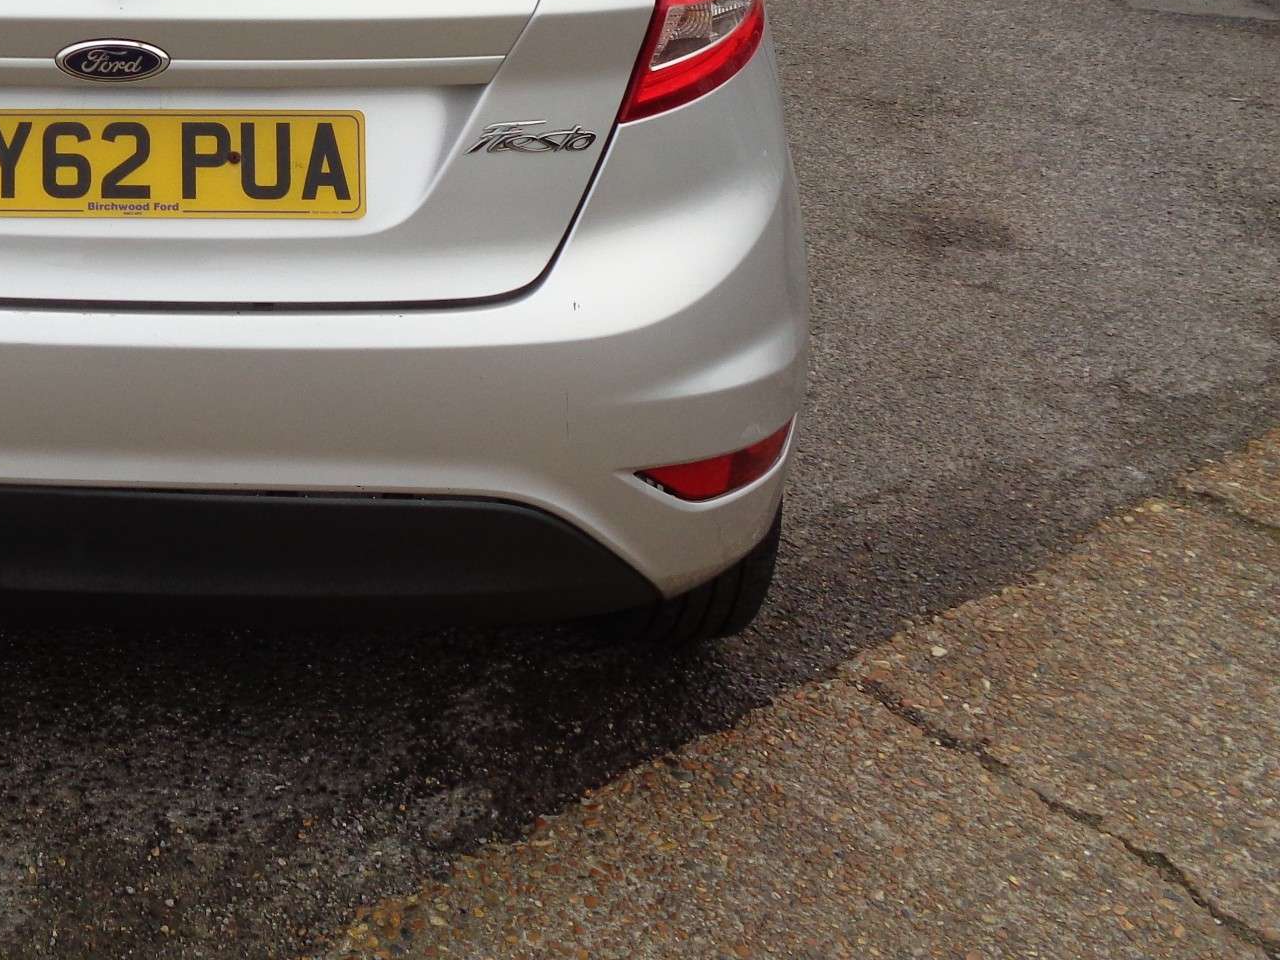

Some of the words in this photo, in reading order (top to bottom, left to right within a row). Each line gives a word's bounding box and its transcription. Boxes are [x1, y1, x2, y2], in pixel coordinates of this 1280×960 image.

[81, 48, 143, 74] Ford
[181, 121, 352, 201] PUA
[87, 202, 150, 211] Birchwood
[153, 202, 180, 211] Ford
